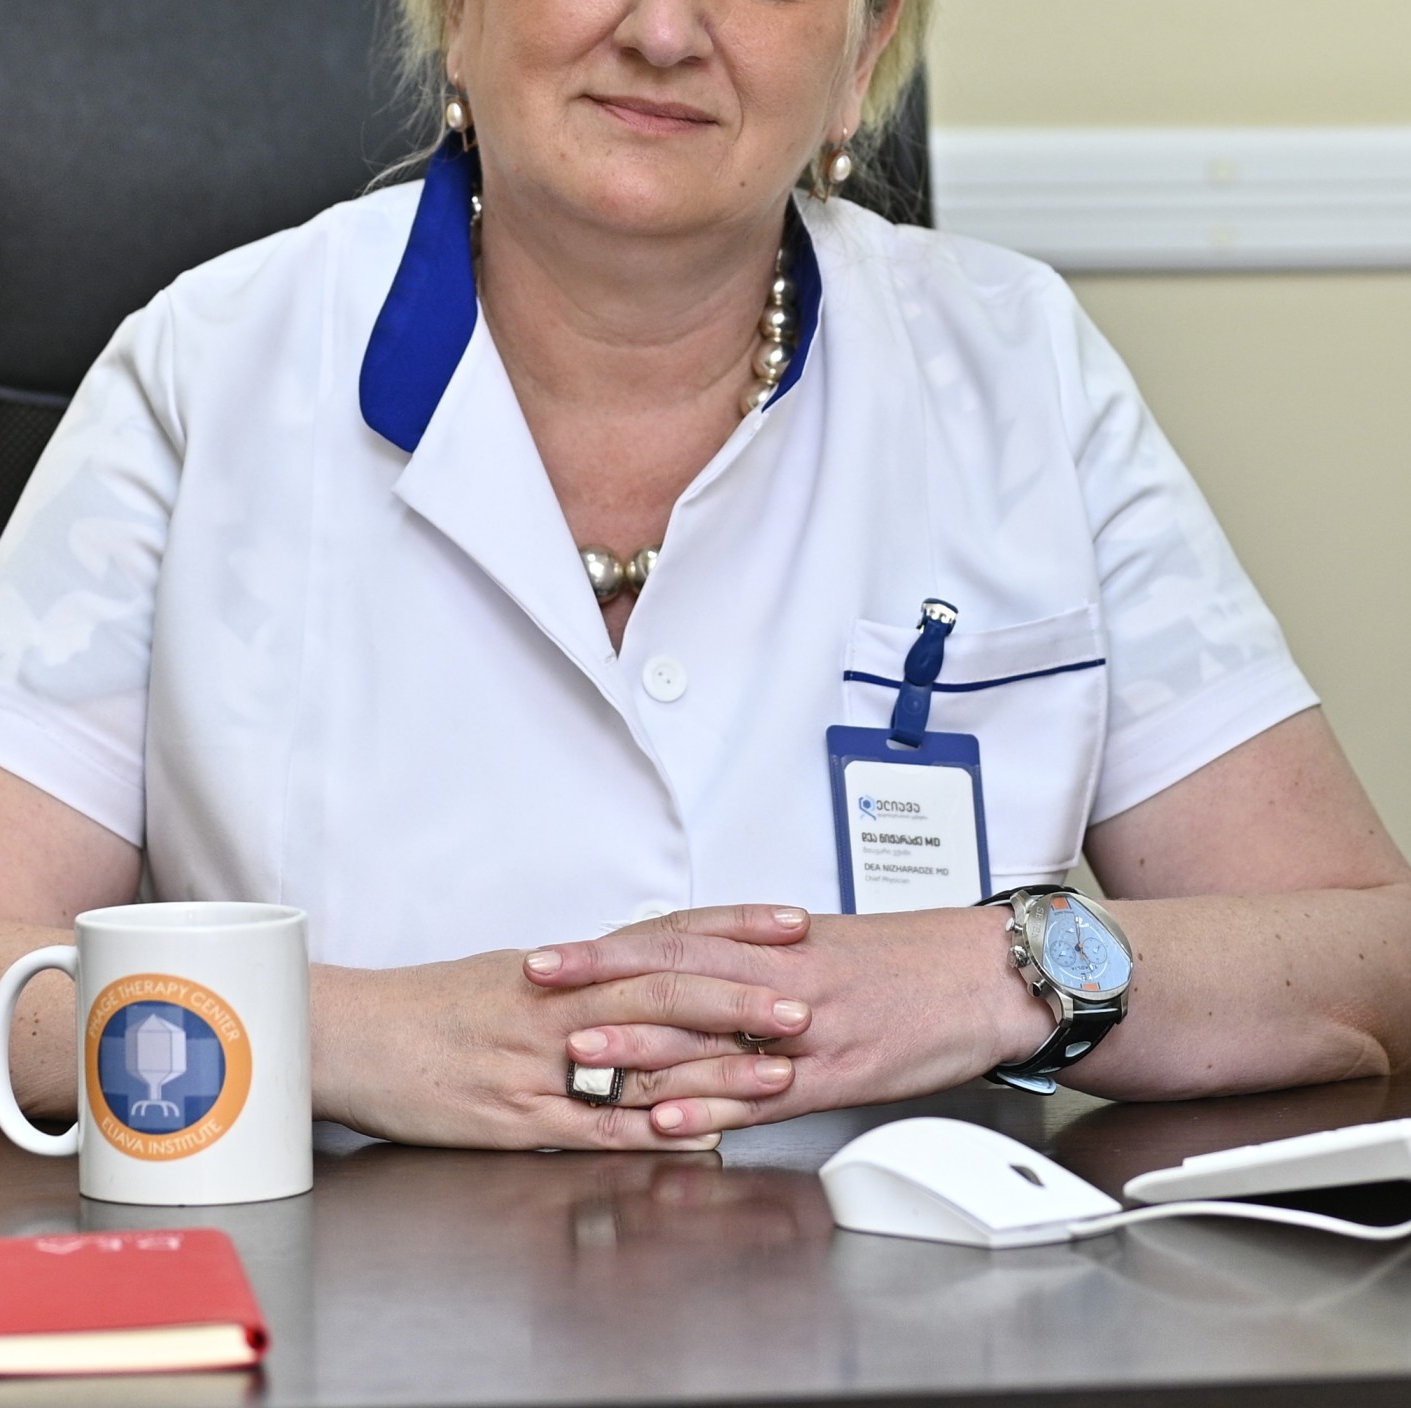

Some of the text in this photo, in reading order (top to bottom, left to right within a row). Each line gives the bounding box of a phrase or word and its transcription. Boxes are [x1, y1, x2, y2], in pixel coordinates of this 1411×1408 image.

[925, 837, 941, 847] MD
[864, 863, 949, 876] DEA NIZHARADZE MD
[89, 980, 241, 1042] PHAGE THERAPY CENTER
[102, 1116, 223, 1155] ELIAVA INSTITUTE
